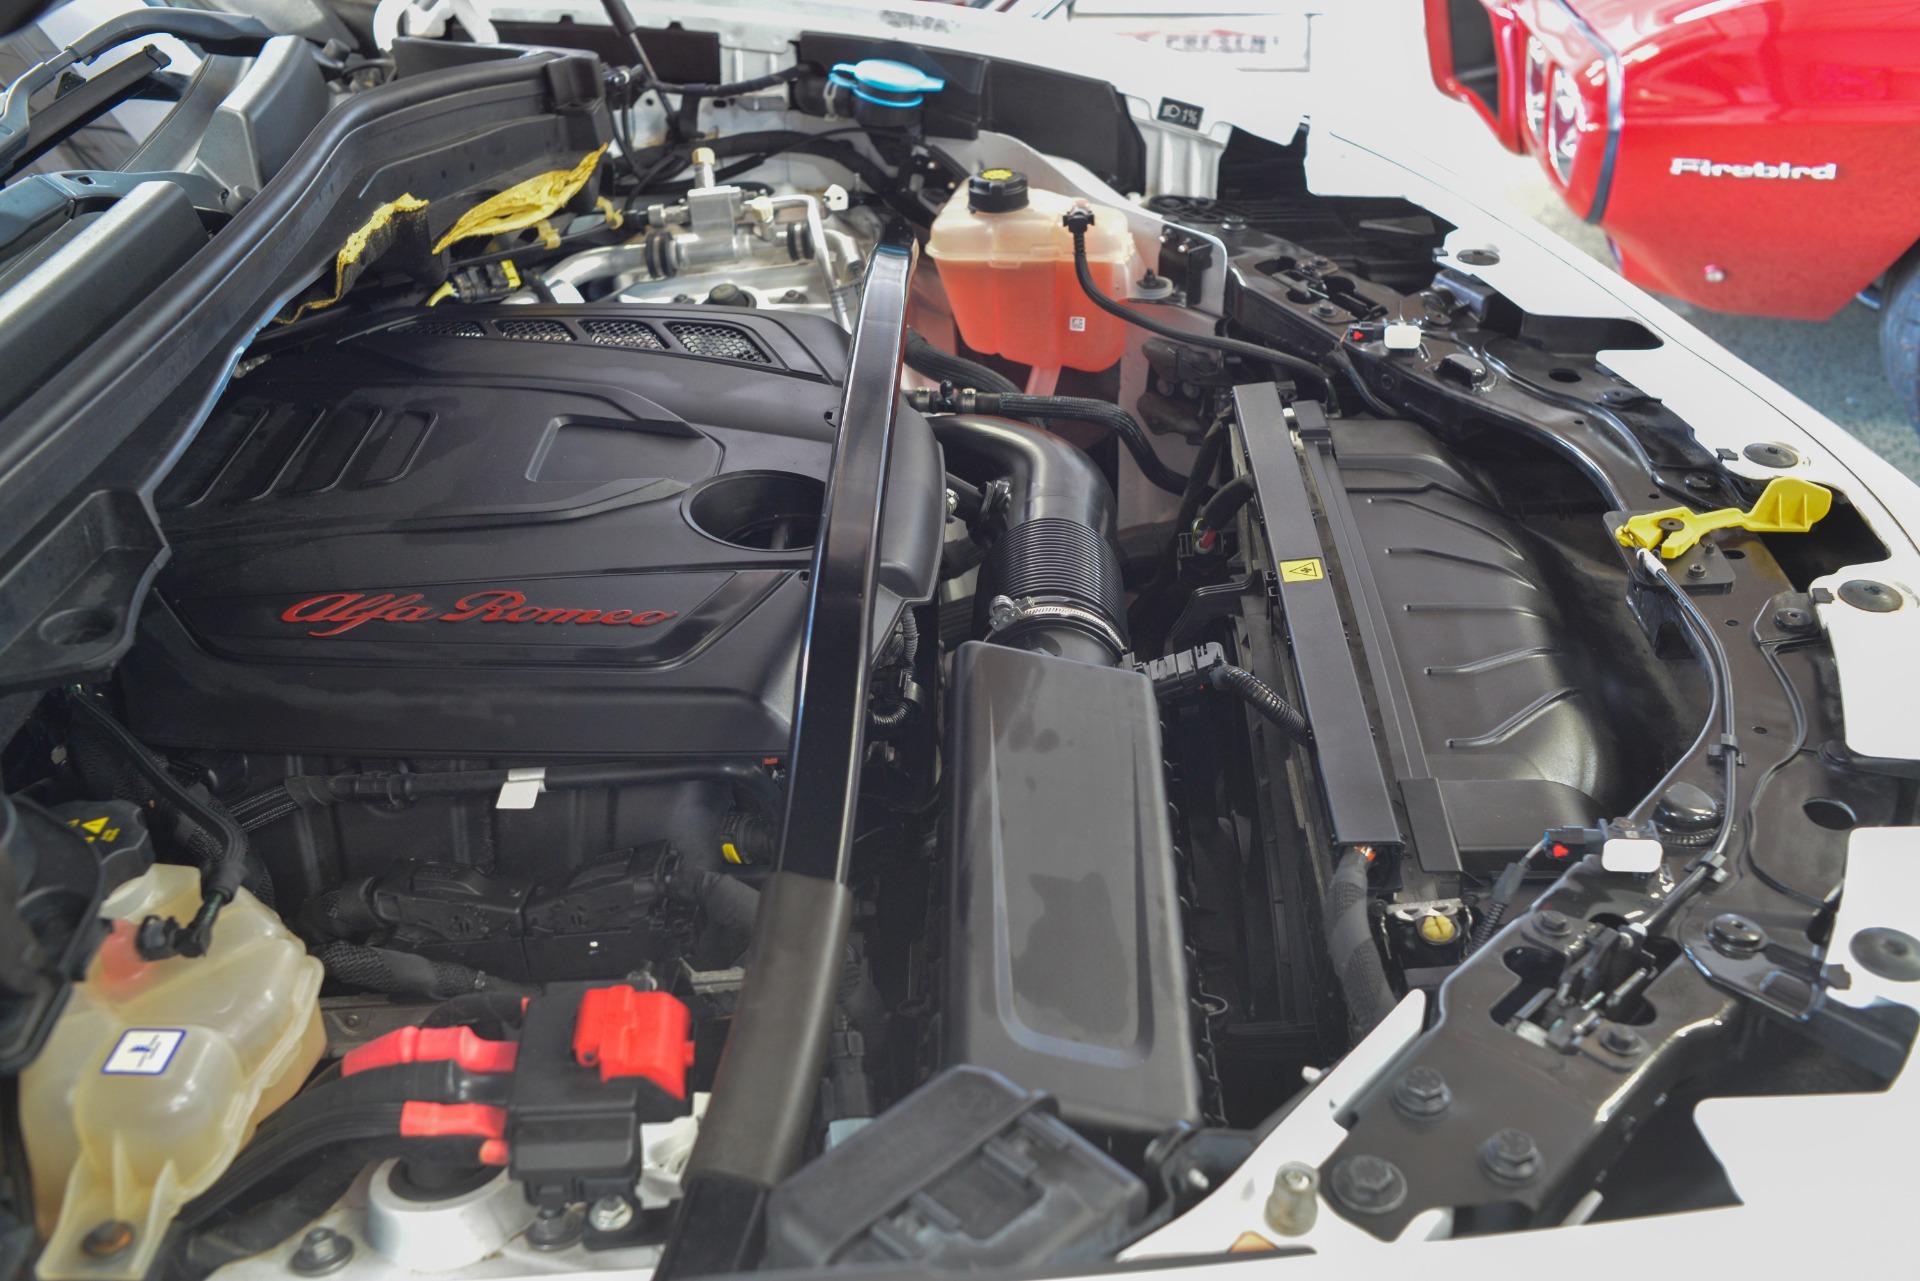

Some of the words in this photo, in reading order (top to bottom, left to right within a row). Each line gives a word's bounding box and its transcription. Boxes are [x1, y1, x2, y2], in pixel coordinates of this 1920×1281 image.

[1670, 157, 1837, 180] Firebird
[281, 593, 440, 637] Alfa
[439, 590, 679, 627] Romeo
